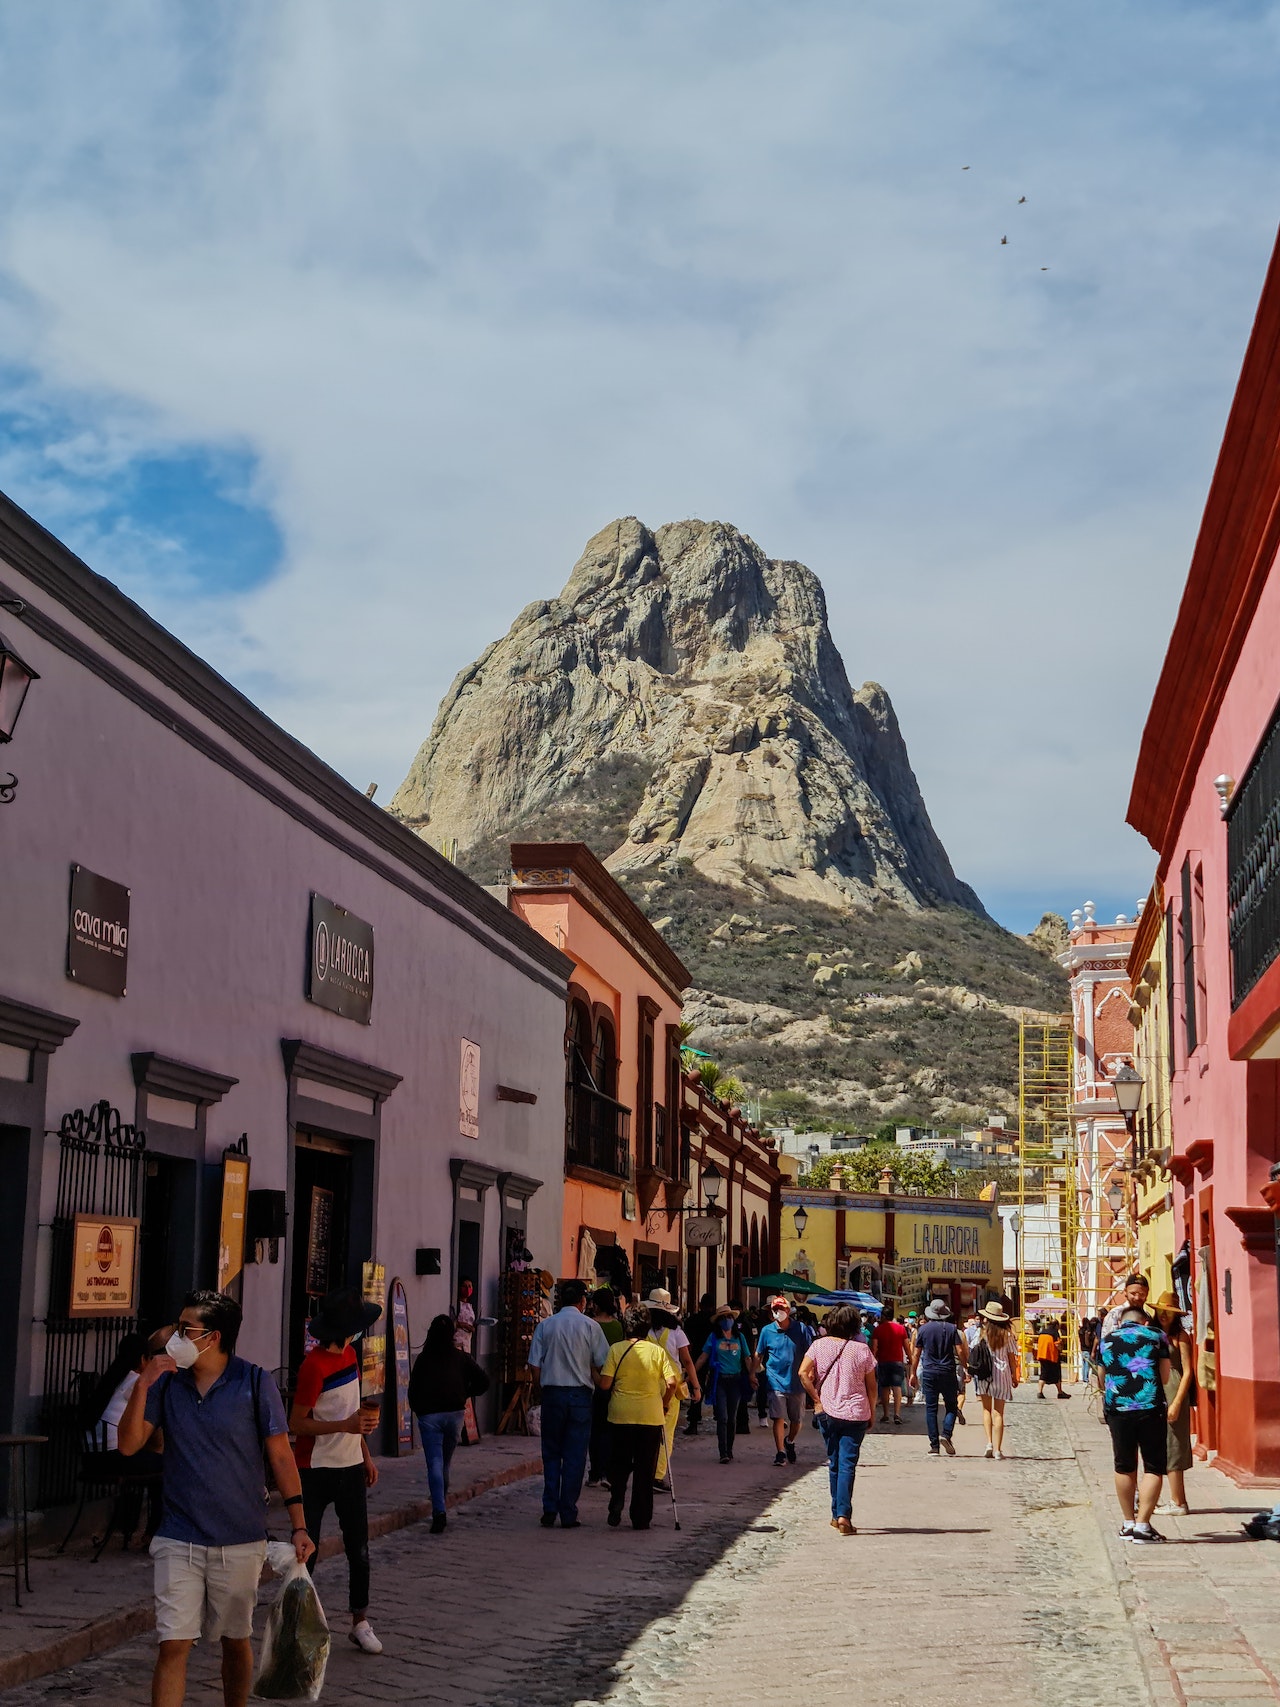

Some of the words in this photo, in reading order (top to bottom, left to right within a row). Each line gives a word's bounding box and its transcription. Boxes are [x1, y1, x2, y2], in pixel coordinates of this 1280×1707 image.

[74, 909, 101, 939] cava
[914, 1223, 930, 1253] LA
[931, 1224, 979, 1256] AURORA
[941, 1259, 992, 1275] ARTESANAL
